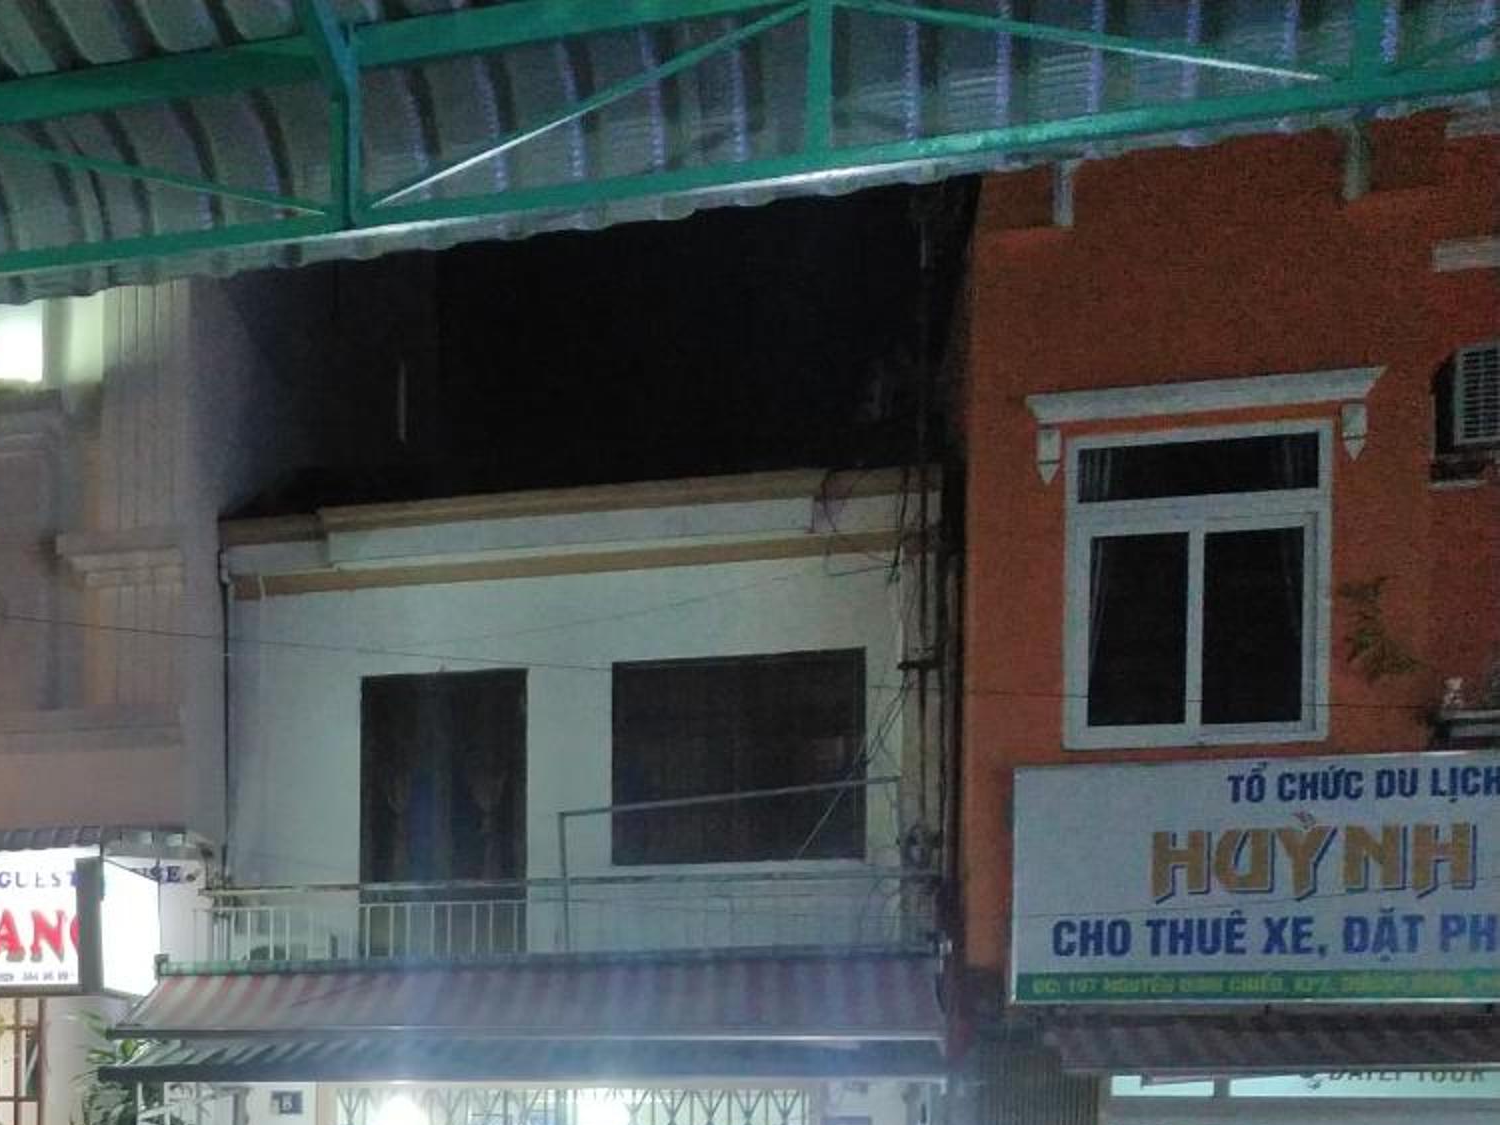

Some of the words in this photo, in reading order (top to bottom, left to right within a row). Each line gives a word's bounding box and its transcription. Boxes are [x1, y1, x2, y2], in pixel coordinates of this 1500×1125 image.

[1227, 761, 1268, 803] TỔ
[1277, 765, 1364, 802] CHỨC
[1375, 767, 1419, 798] DU
[1150, 811, 1477, 904] HUỲNH
[1052, 919, 1131, 957] CHO
[1146, 910, 1247, 956] THUÊ
[1262, 915, 1328, 959] XE,
[1342, 907, 1426, 962] ĐẶT
